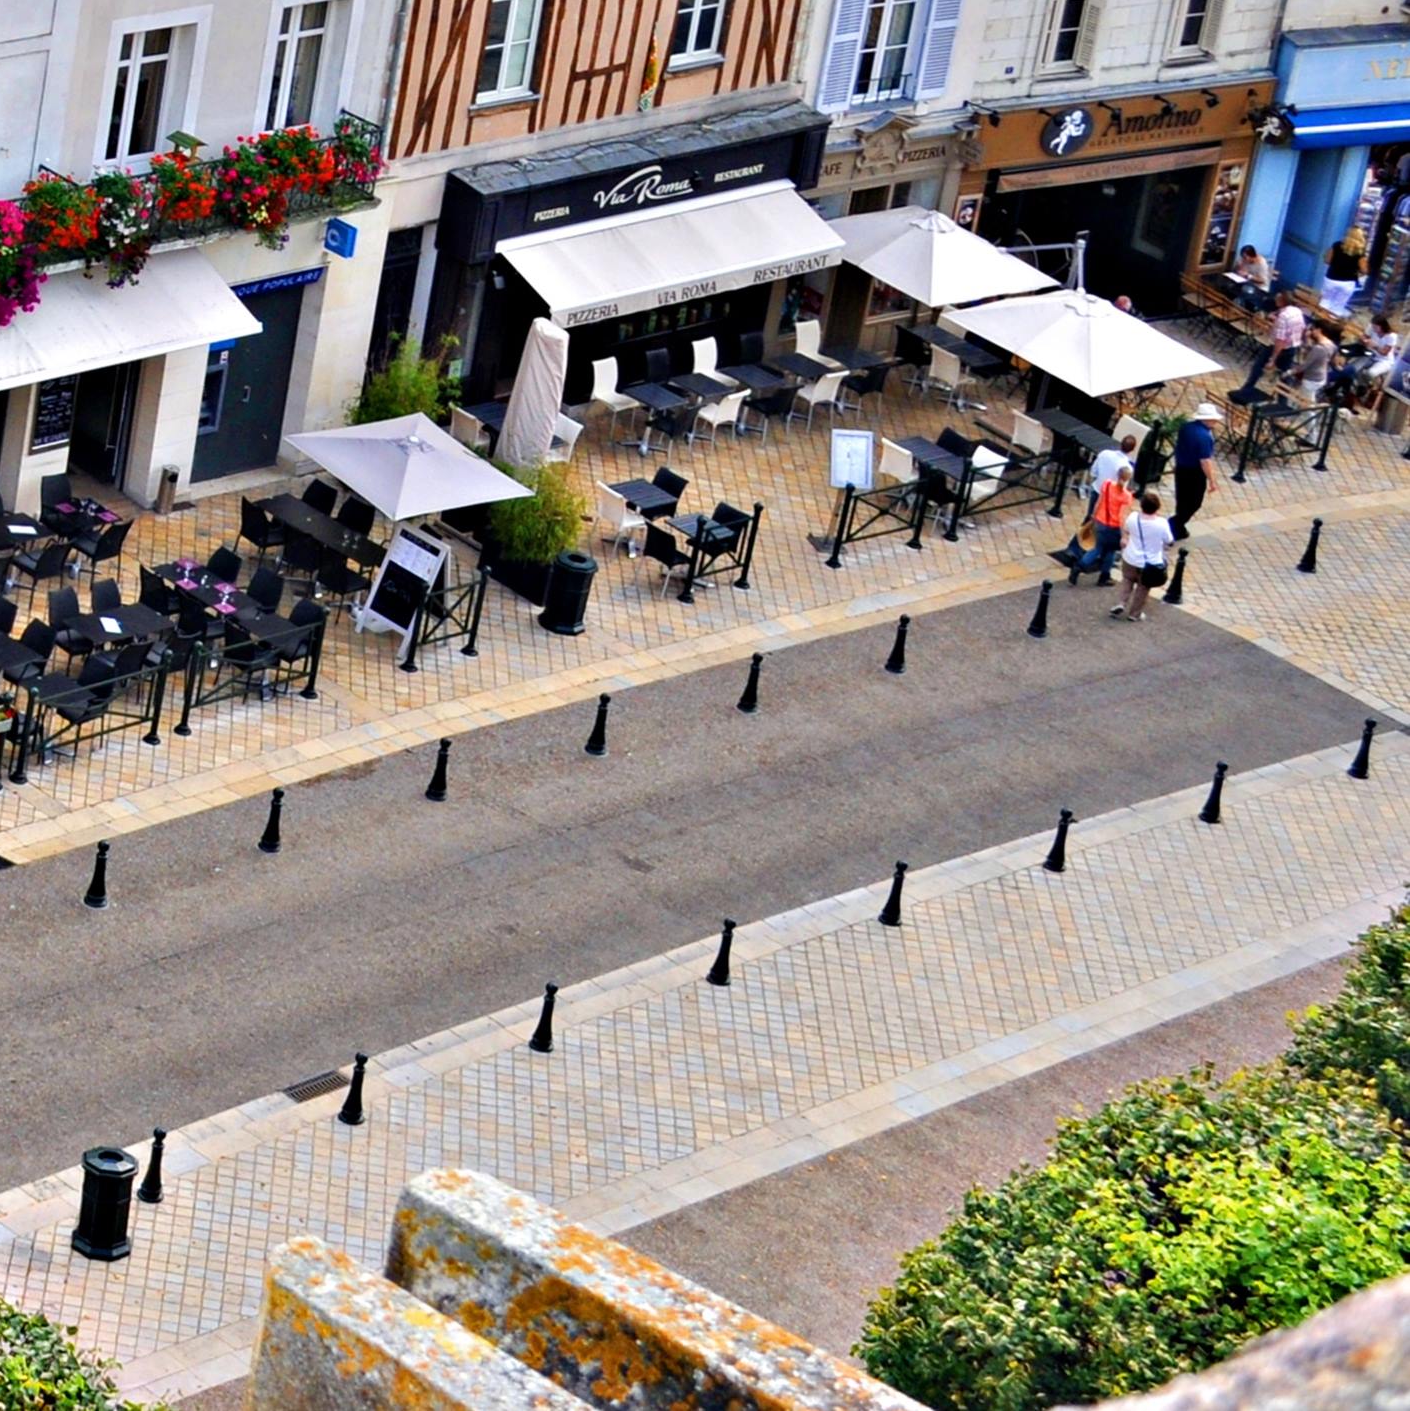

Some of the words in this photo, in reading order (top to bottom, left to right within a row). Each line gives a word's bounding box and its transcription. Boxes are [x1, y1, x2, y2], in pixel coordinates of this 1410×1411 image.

[1101, 107, 1202, 137] Amorino
[901, 145, 947, 164] PIZZERIA
[534, 205, 570, 222] PIZZERIA
[633, 173, 694, 204] Roma
[714, 163, 765, 183] RESTAURANT
[566, 303, 620, 326] PIZZERIA
[656, 289, 678, 306] VIA
[680, 280, 718, 300] ROMA
[752, 254, 830, 284] RESTAURANT
